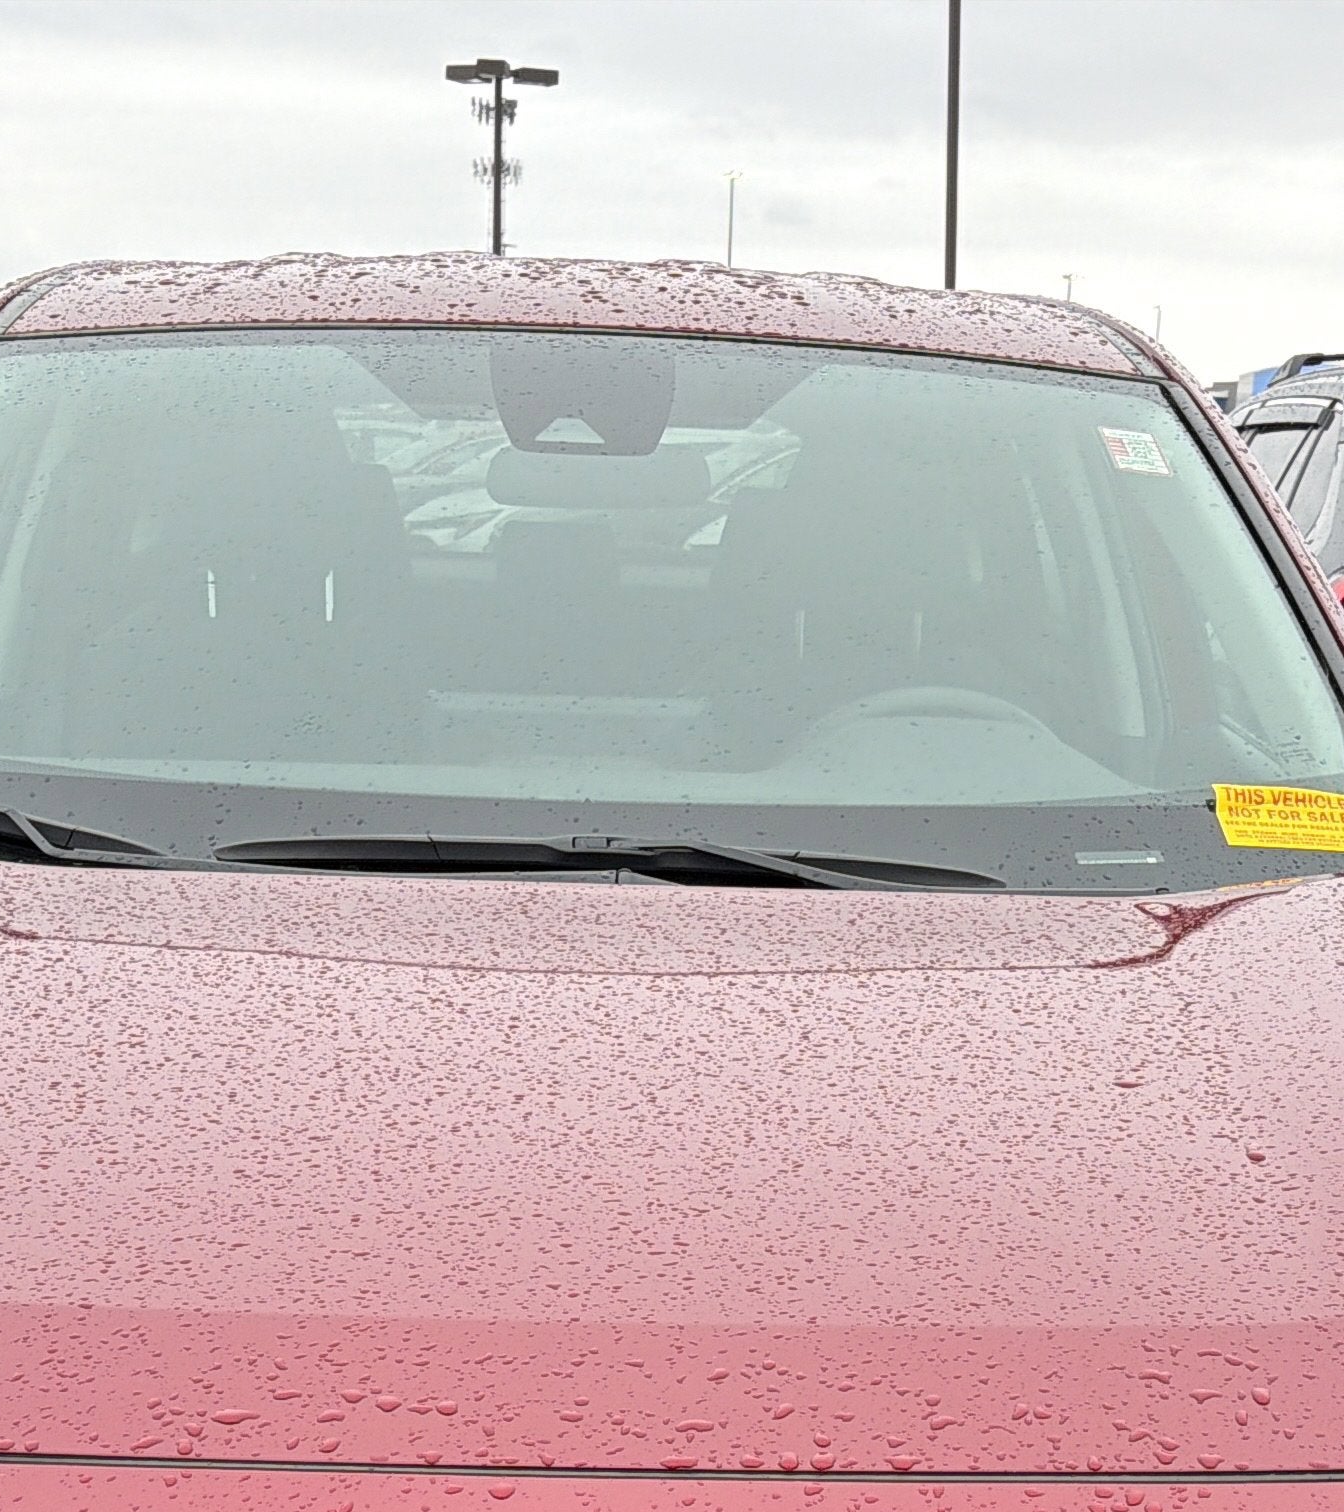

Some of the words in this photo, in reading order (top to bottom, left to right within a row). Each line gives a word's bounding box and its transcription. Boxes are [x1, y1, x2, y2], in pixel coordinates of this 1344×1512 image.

[1221, 787, 1266, 805] THIS
[1227, 805, 1261, 819] NOT
[1266, 809, 1302, 821] FOR
